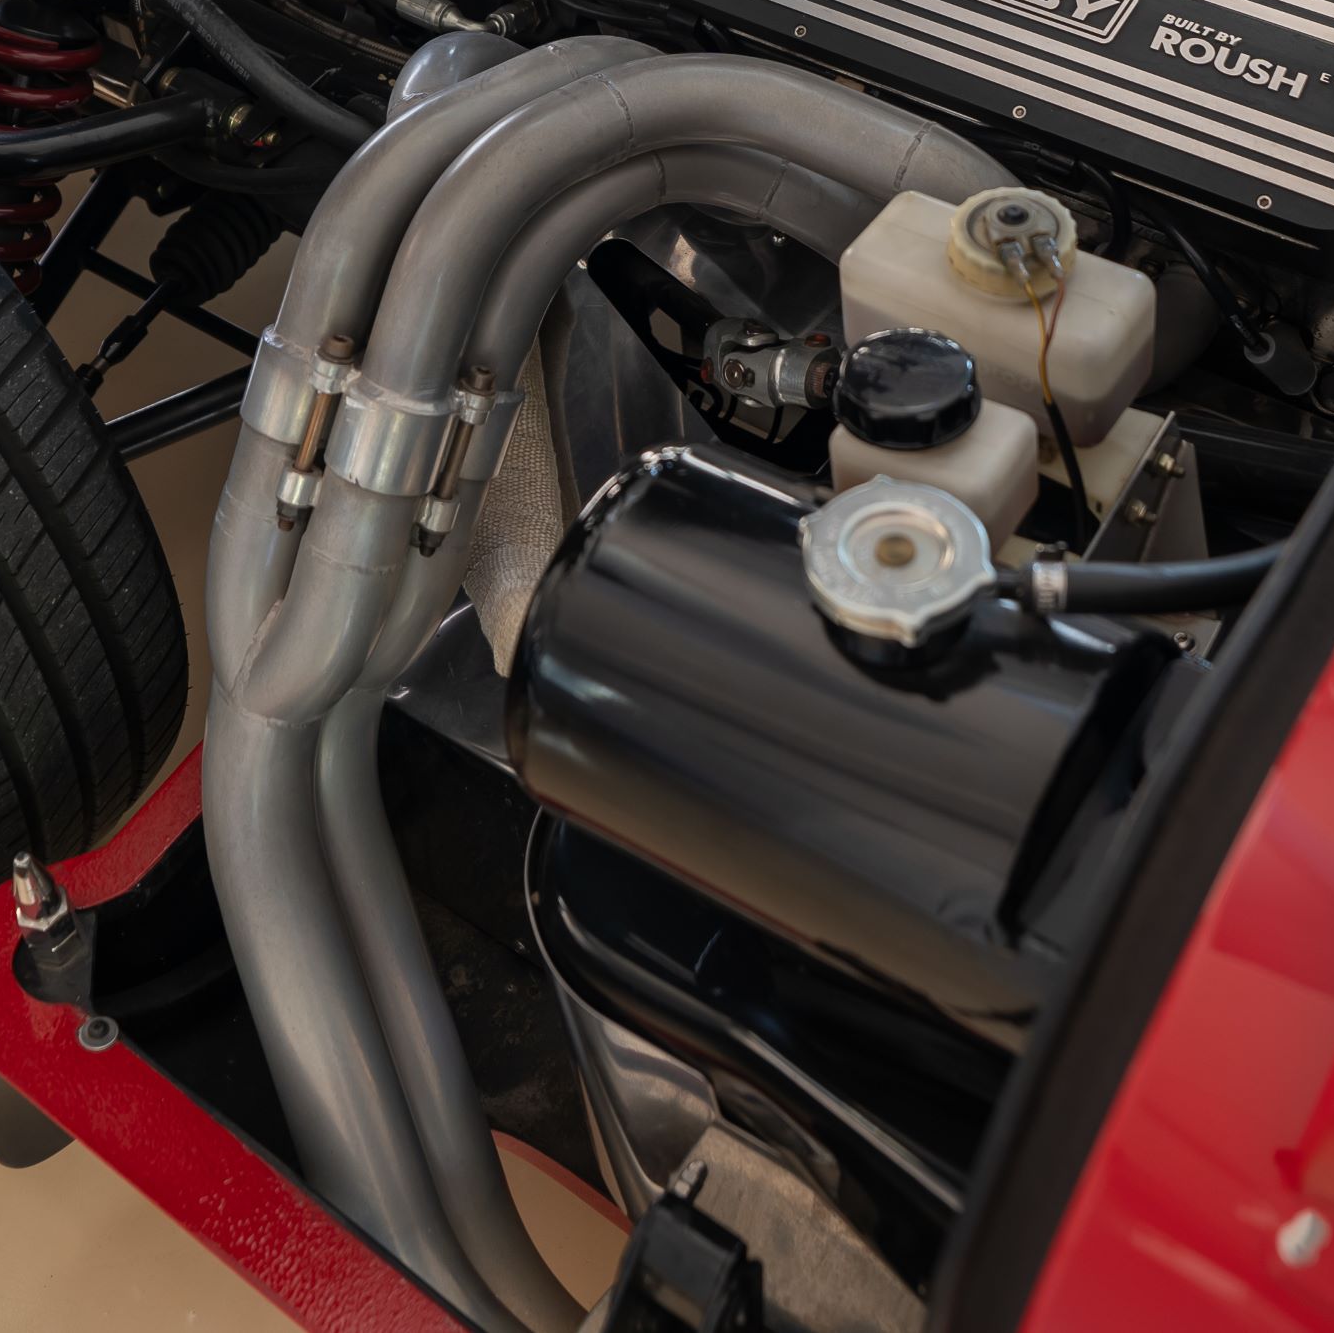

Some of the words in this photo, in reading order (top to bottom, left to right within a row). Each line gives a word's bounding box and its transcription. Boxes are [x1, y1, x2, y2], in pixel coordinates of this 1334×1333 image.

[1162, 13, 1215, 36] BUILT
[1215, 31, 1242, 46] BY
[1150, 25, 1308, 99] ROUSH
